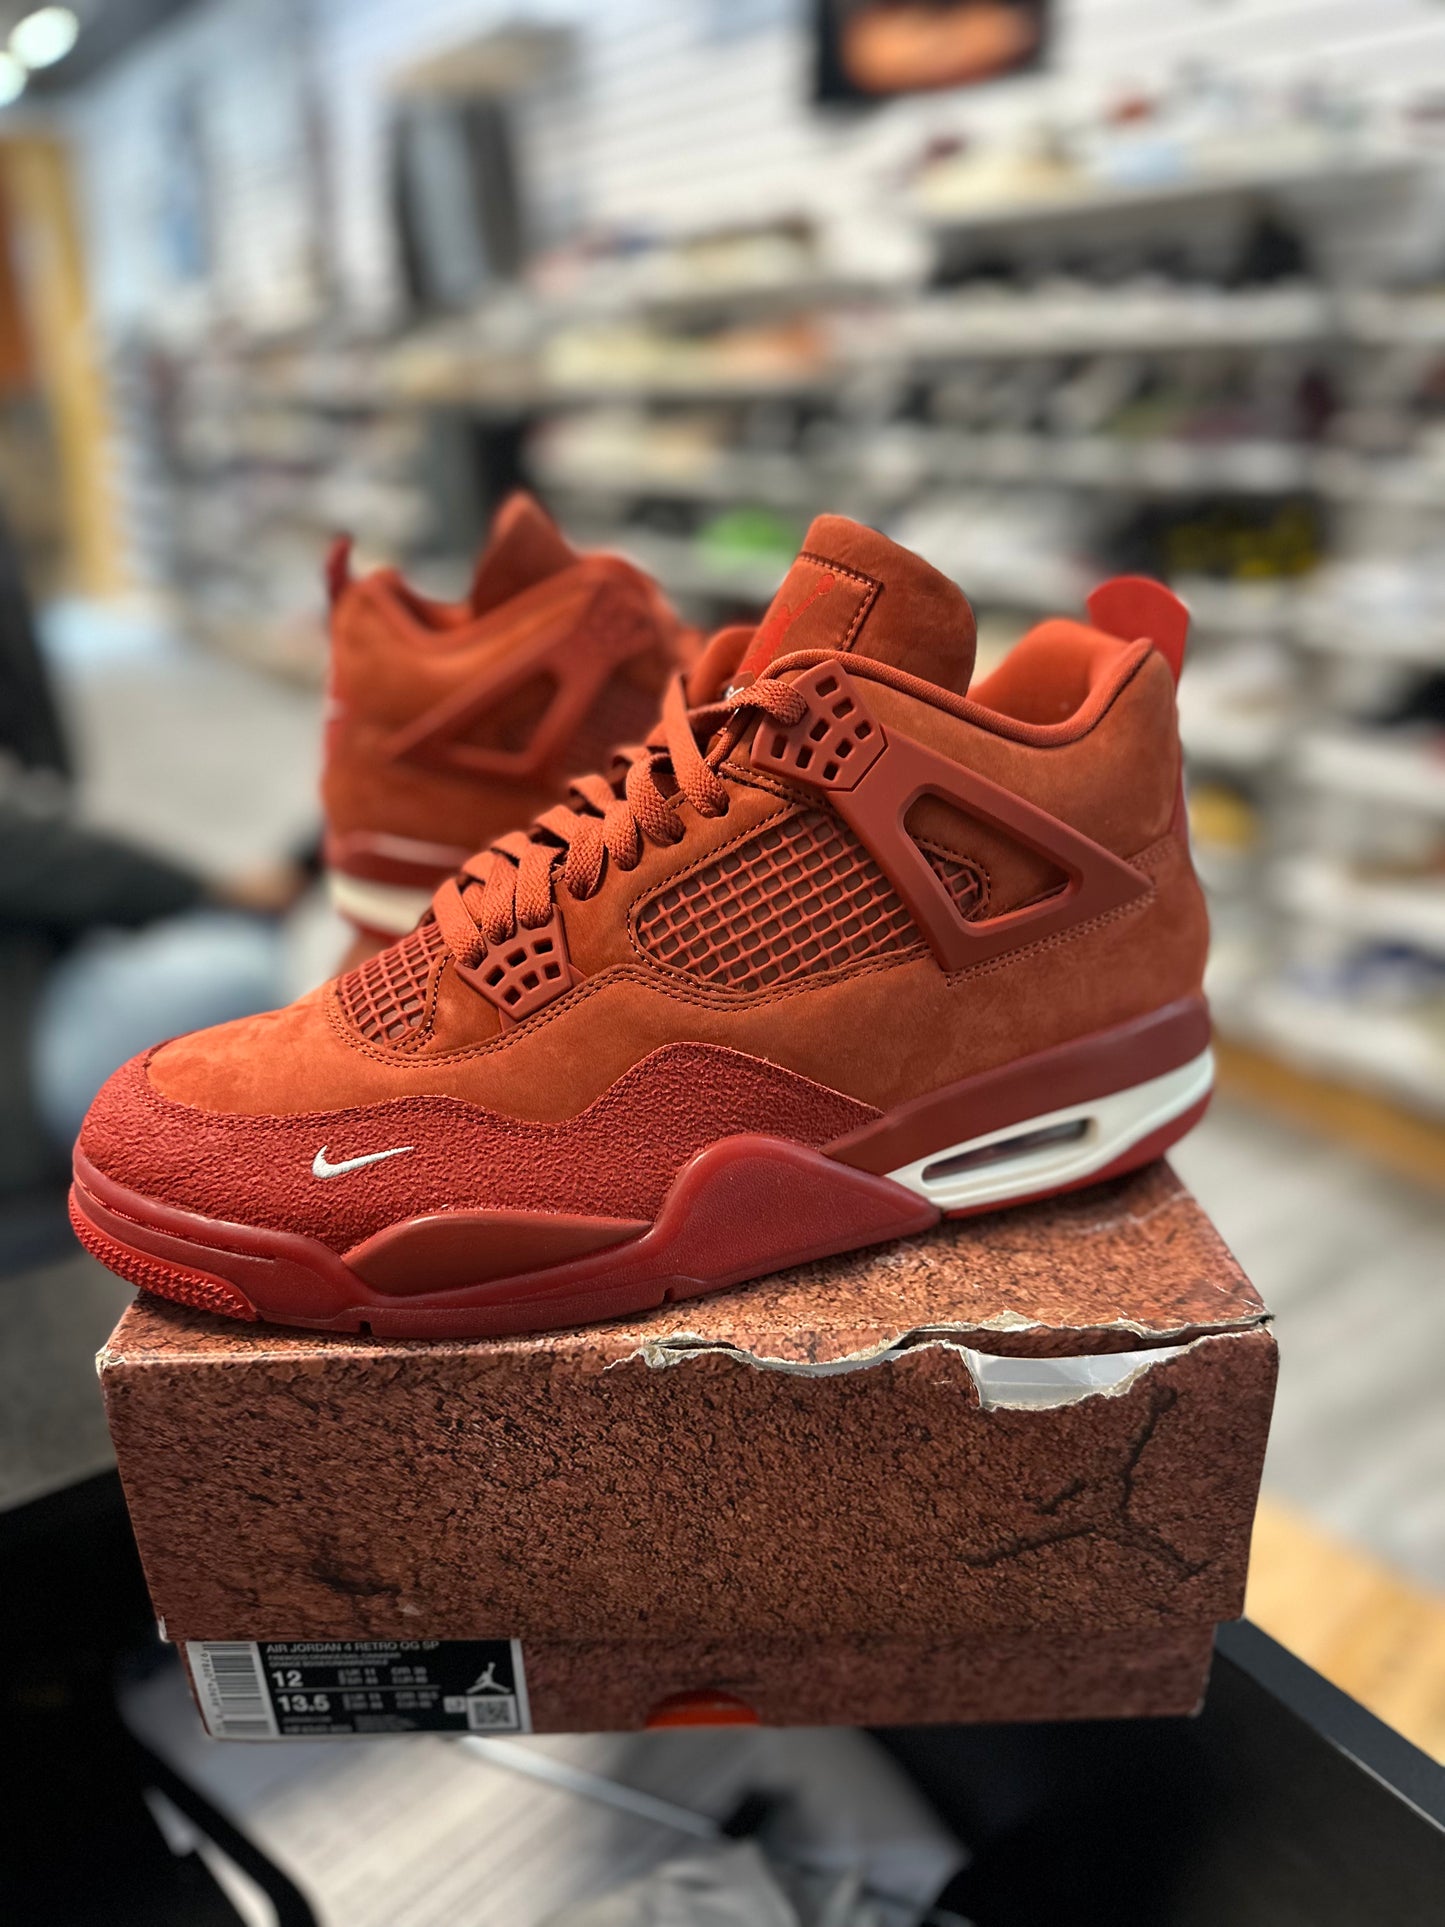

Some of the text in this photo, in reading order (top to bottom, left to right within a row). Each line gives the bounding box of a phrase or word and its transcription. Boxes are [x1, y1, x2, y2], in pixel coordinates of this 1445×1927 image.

[266, 1640, 440, 1654] AIR JORDAN 4 RETRO OG SP
[272, 1669, 304, 1688] 12
[277, 1693, 330, 1713] 13.5
